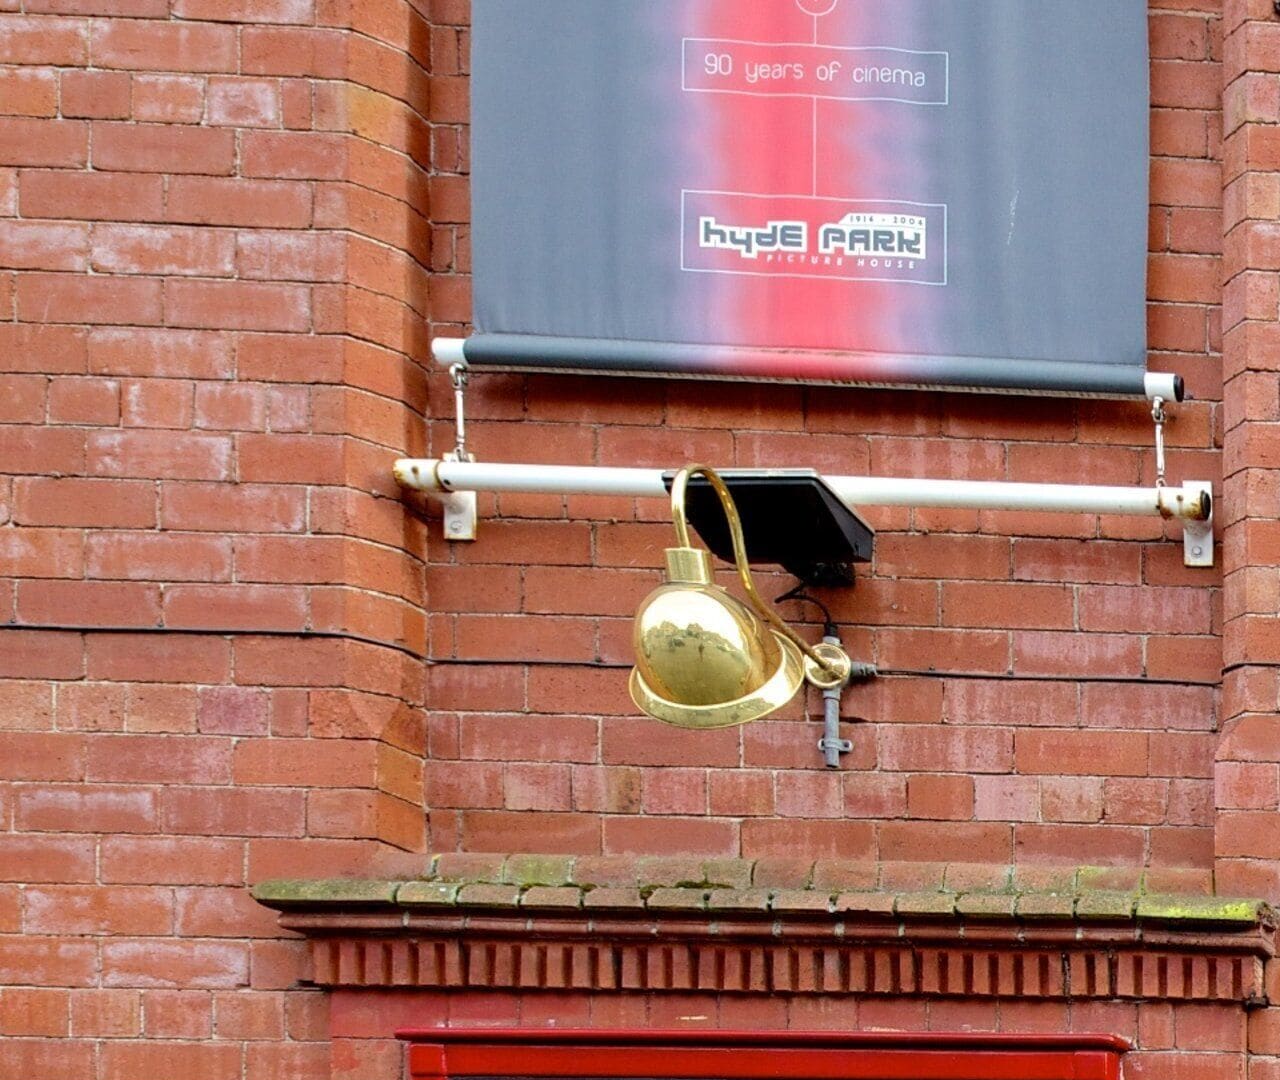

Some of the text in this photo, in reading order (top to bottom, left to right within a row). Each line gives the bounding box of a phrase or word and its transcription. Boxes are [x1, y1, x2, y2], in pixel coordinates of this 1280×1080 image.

[704, 53, 926, 88] 90 years of cinema
[822, 227, 922, 255] PARK
[766, 254, 916, 269] PICTURE HOUSE
